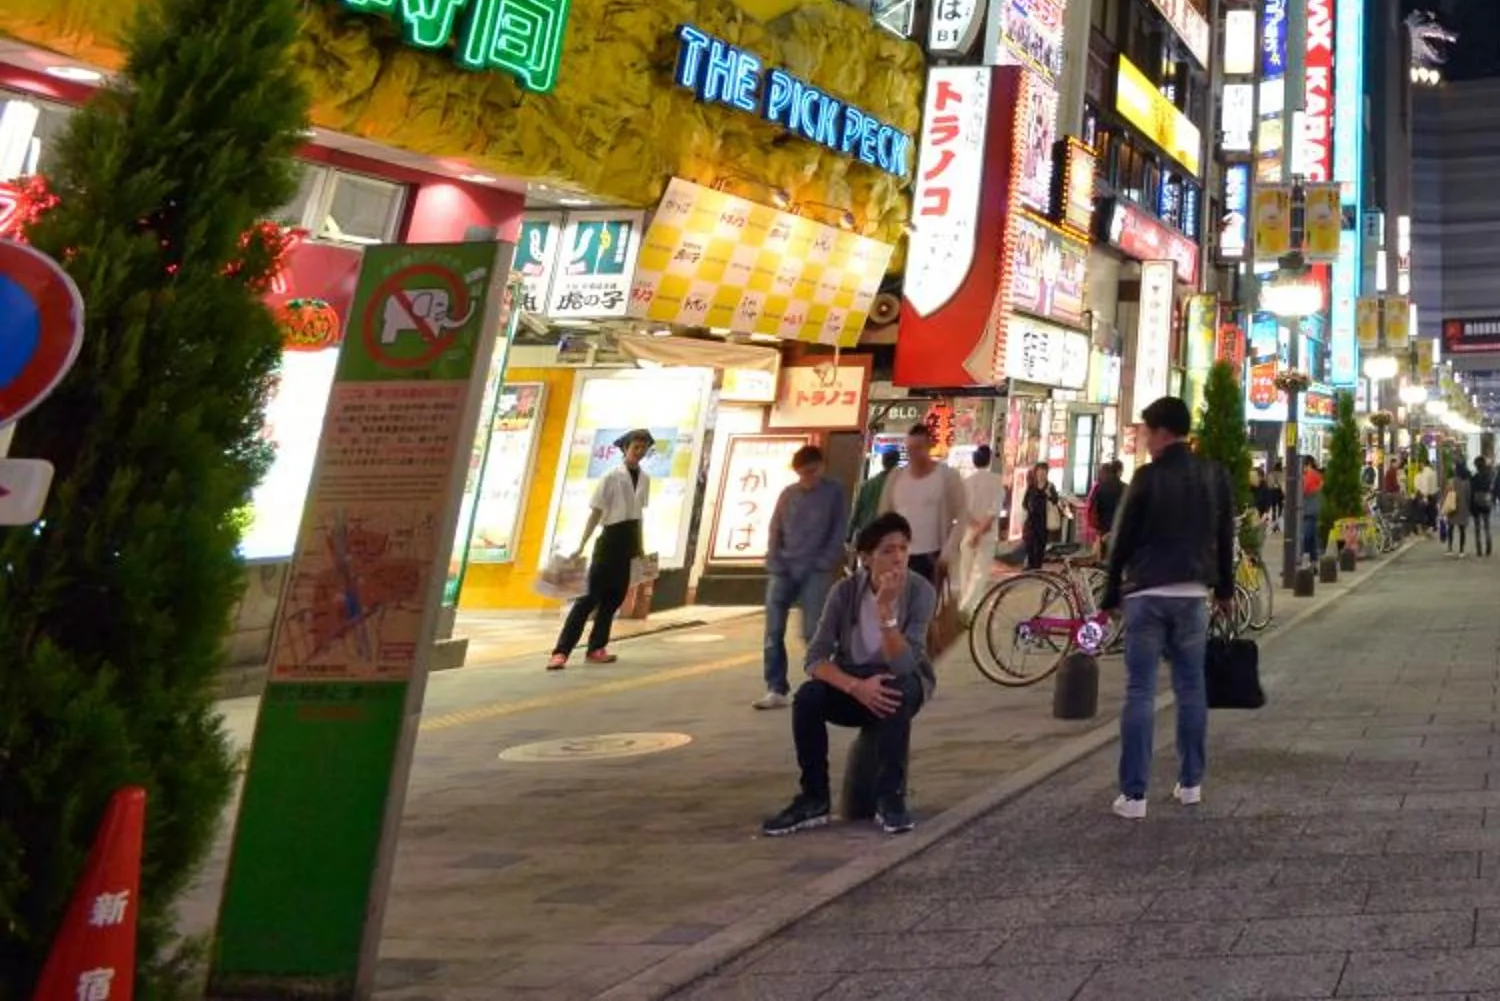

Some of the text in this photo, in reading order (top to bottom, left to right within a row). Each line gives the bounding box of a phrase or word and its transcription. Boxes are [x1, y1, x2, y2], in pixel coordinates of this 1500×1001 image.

[678, 25, 760, 111] THE
[766, 69, 842, 151] PICK
[843, 107, 911, 178] PECK
[920, 80, 963, 217] トラノコ
[556, 288, 625, 312] 虎の子
[794, 389, 857, 409] トラノコ
